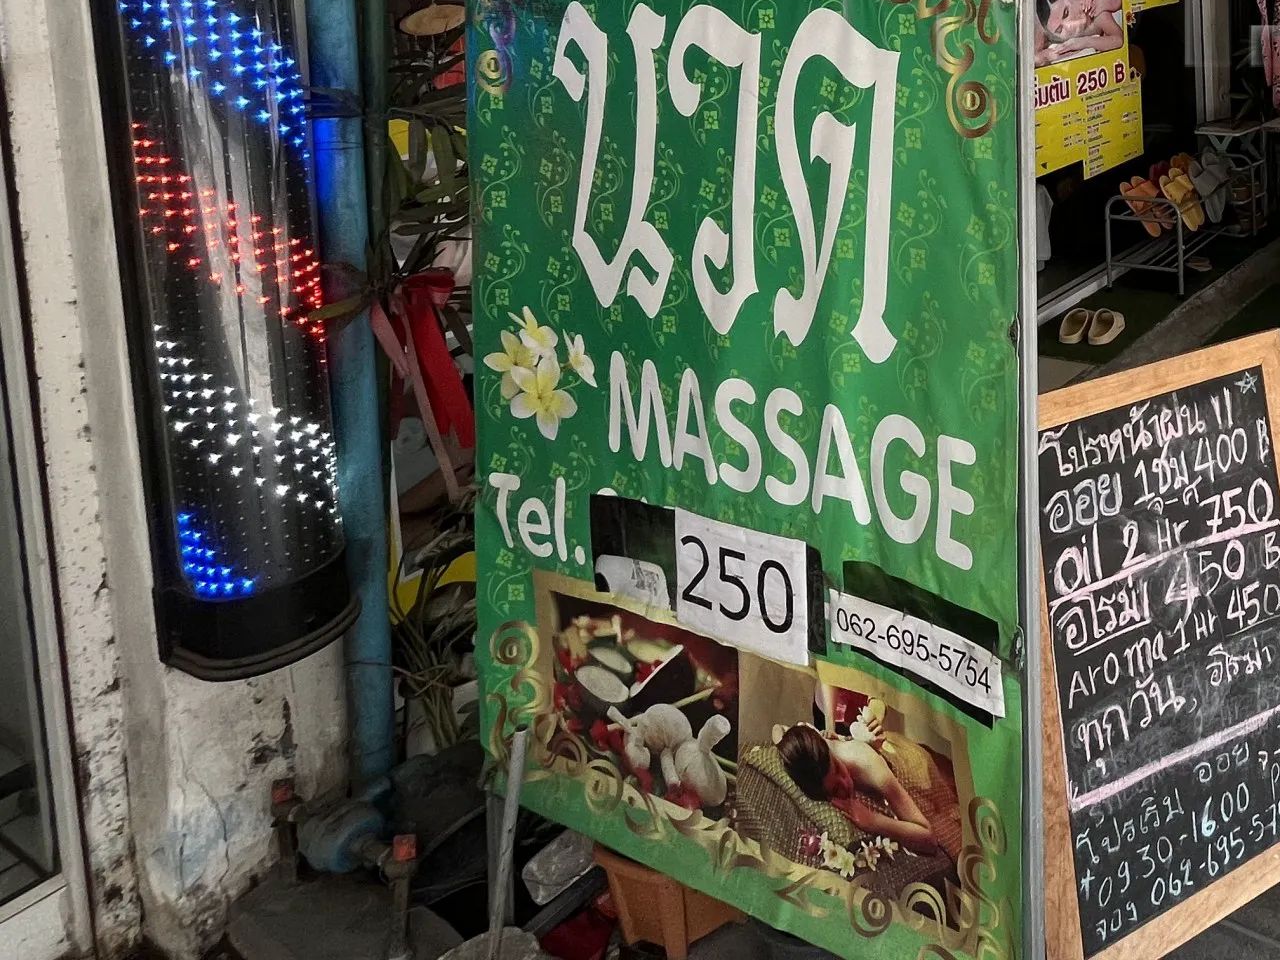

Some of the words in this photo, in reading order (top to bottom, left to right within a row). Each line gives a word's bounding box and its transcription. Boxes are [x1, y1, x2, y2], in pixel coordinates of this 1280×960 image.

[1076, 66, 1108, 96] 250
[552, 0, 902, 365] นวด
[608, 350, 978, 571] MASSAGE
[1043, 471, 1124, 534] ออย
[1193, 427, 1248, 484] 400
[488, 471, 587, 567] Tel.
[1121, 520, 1149, 569] 2
[1156, 518, 1190, 553] Hr
[1198, 477, 1274, 536] 750
[680, 533, 795, 636] 250
[834, 605, 995, 696] 062-695-5754
[1068, 631, 1168, 710] Aroma
[1168, 617, 1192, 655] 1
[1194, 609, 1219, 641] Hr
[1193, 741, 1250, 784] ออย
[1096, 903, 1139, 942] จอง
